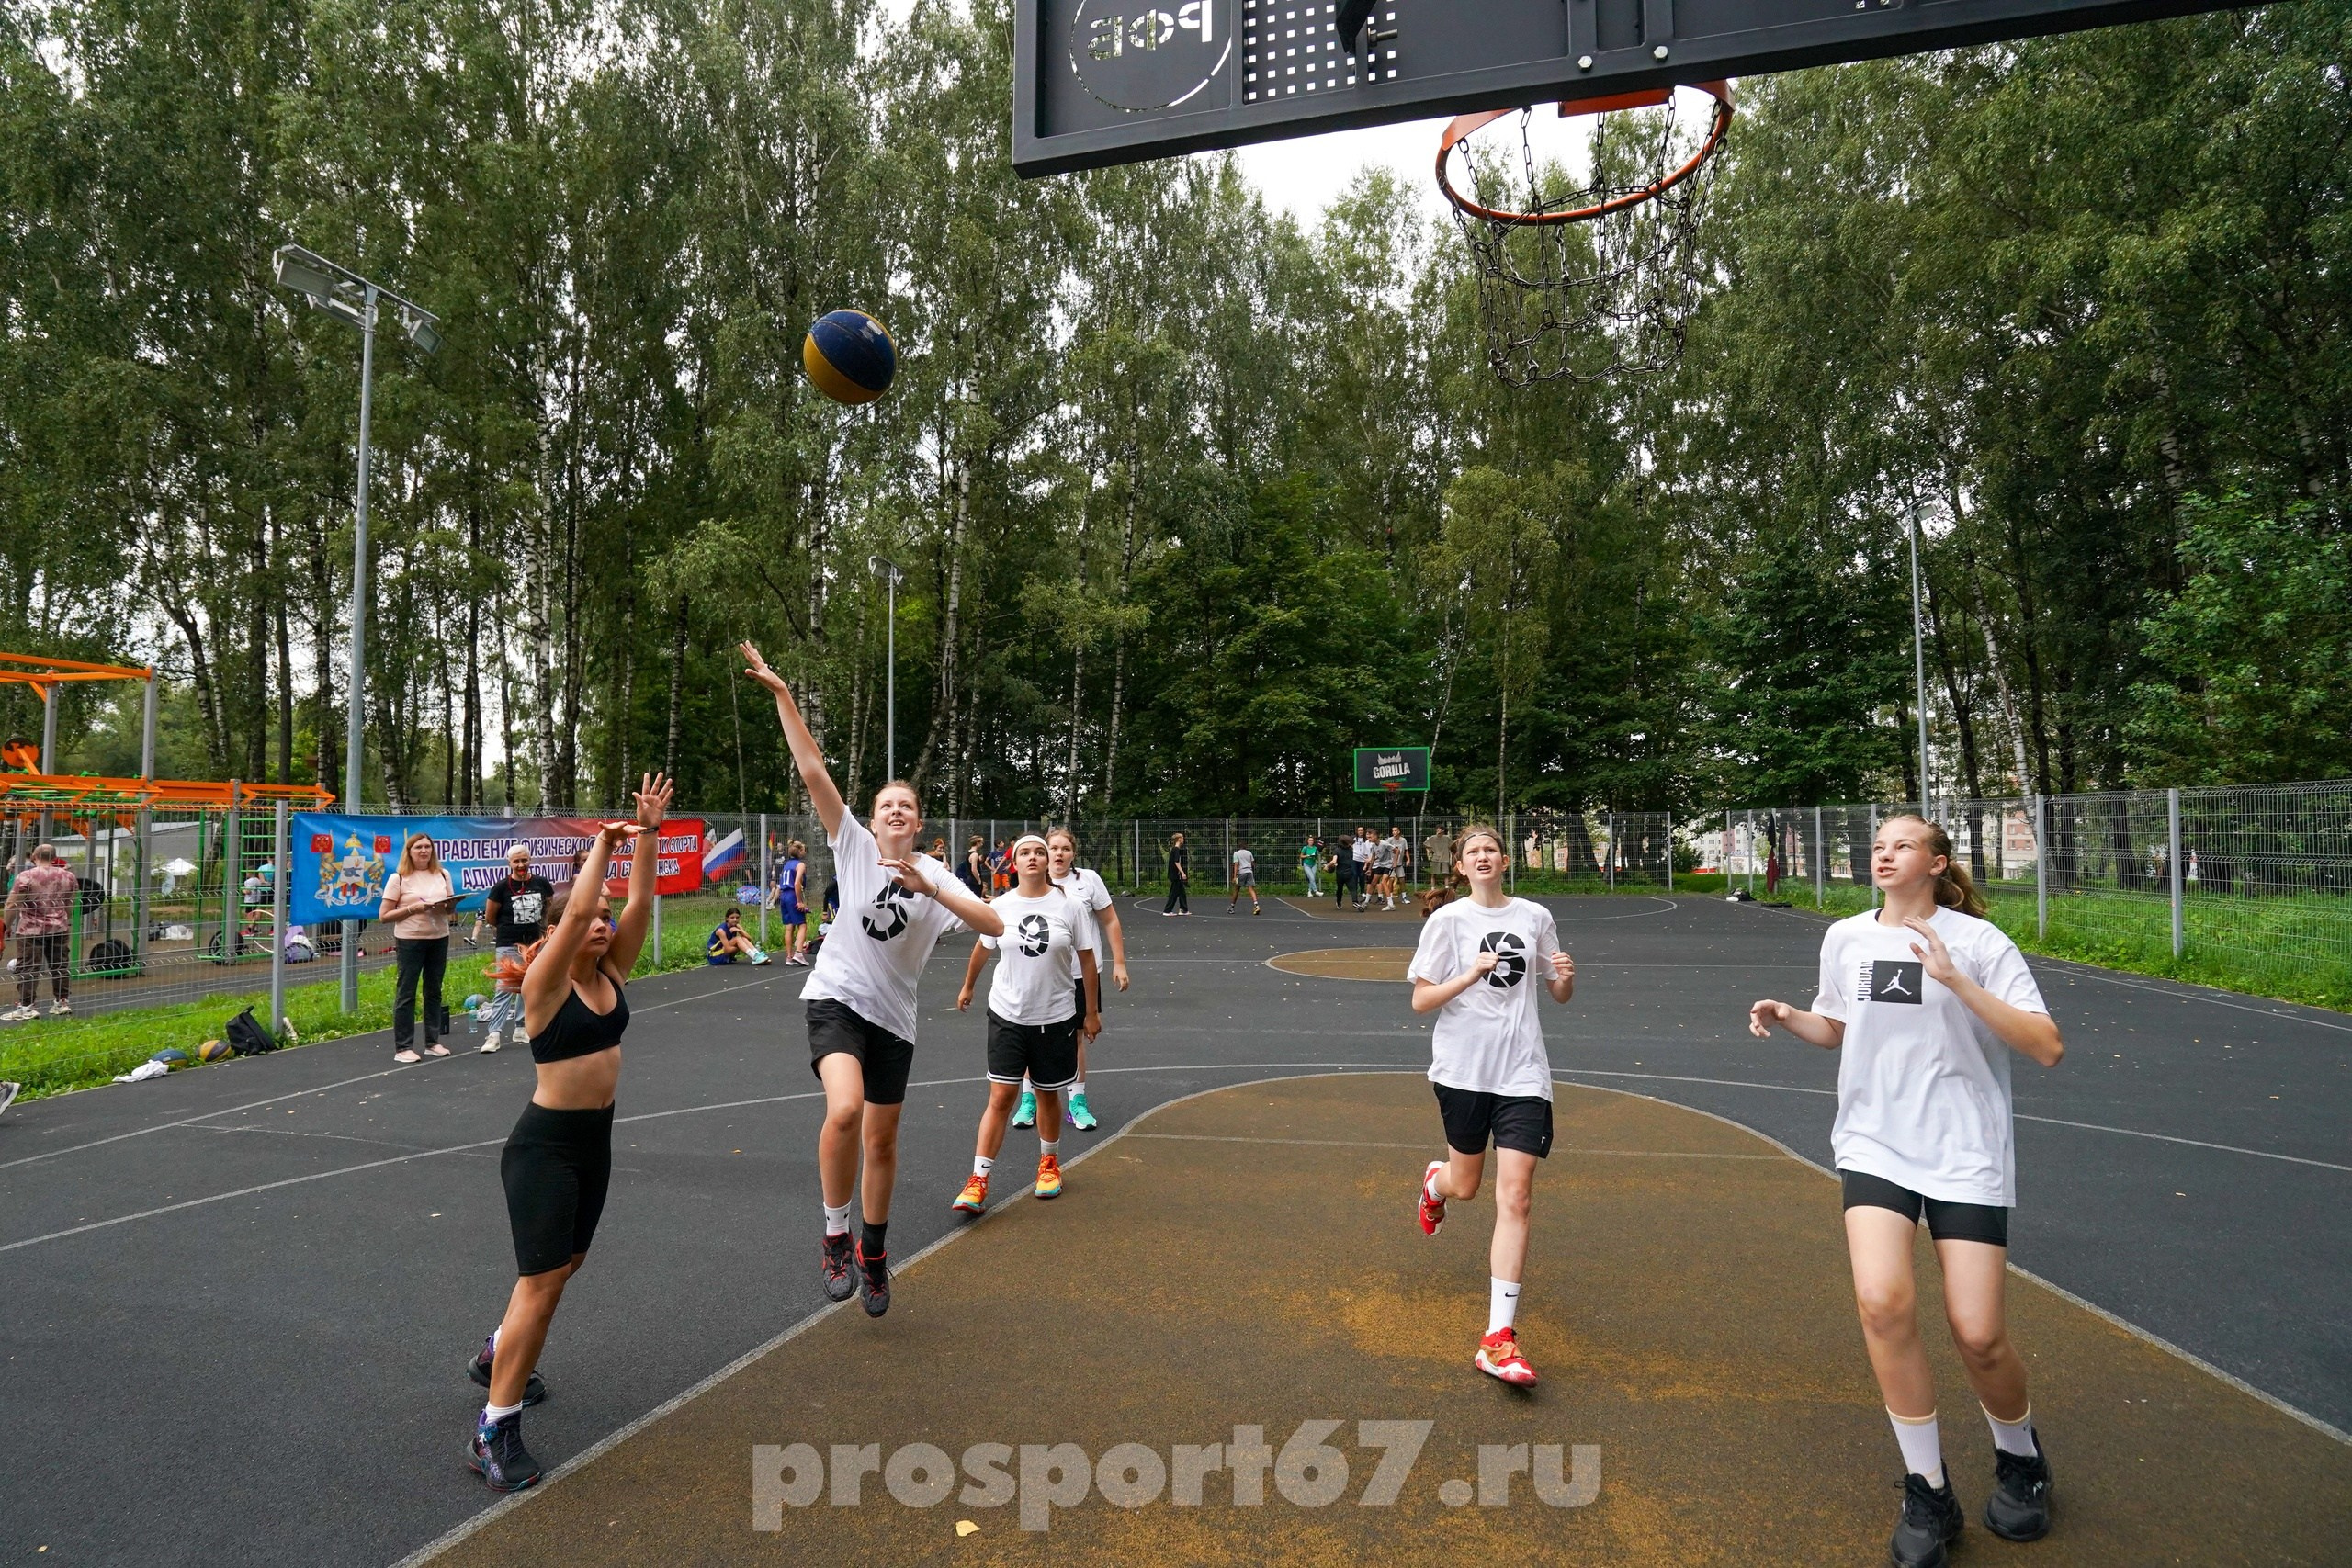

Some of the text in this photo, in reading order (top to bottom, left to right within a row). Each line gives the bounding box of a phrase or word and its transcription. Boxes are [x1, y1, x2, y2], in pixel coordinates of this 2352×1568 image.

[1373, 762, 1411, 779] GORILLA
[433, 839, 517, 861] ПРАВЛЕНИ
[782, 869, 791, 886] 11
[1018, 914, 1050, 958] 9
[1479, 931, 1527, 988] 6
[1857, 960, 1875, 1002] JORDAN
